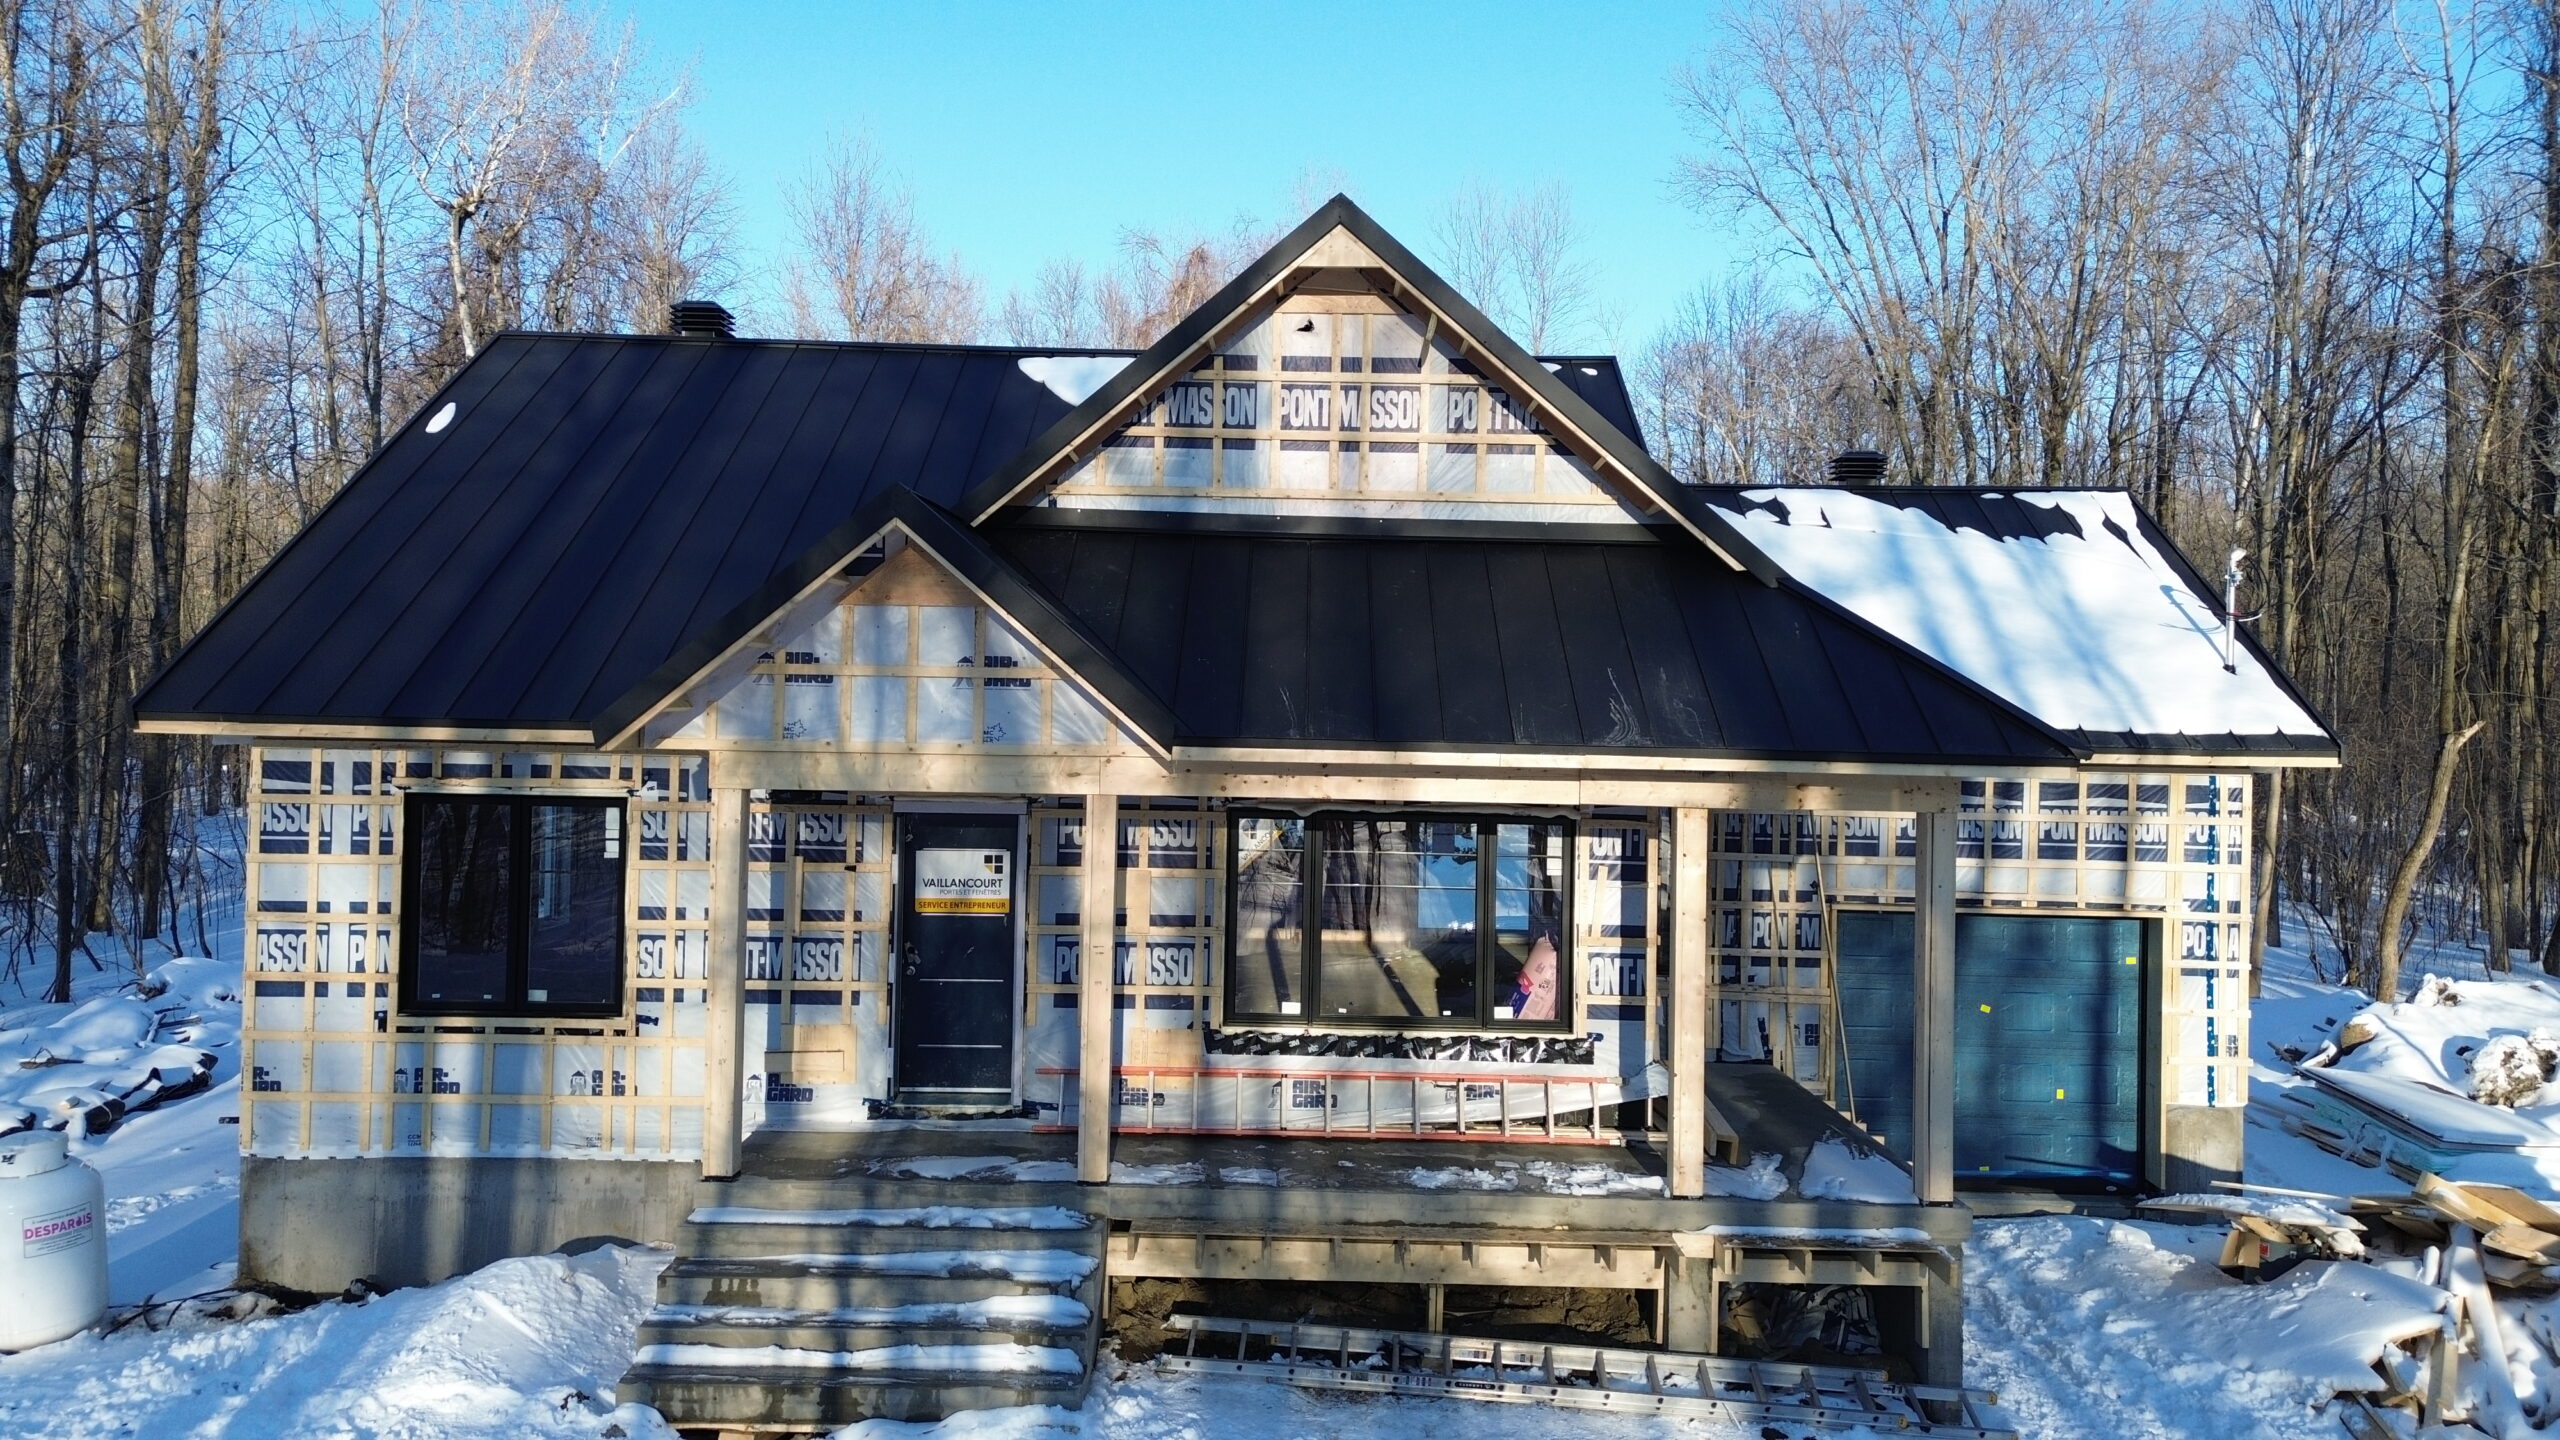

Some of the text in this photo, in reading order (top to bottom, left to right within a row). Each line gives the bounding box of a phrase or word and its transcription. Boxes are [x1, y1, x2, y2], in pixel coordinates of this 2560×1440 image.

[922, 878, 1004, 888] VAILLANCOURT
[414, 1068, 449, 1081] AR-
[592, 1070, 626, 1083] AR-
[1293, 1080, 1325, 1094] AIR-
[767, 1088, 813, 1101] GARD
